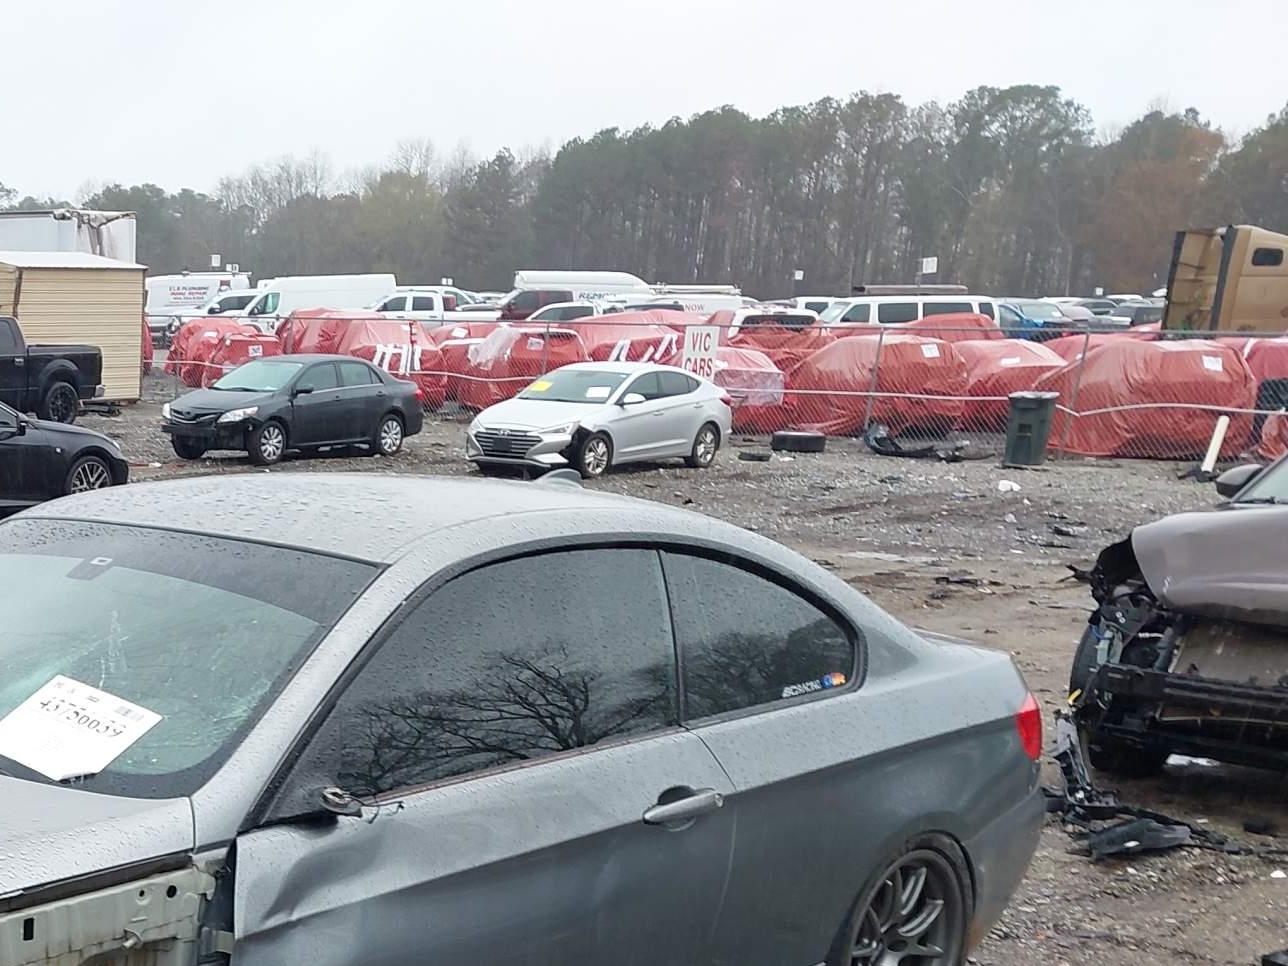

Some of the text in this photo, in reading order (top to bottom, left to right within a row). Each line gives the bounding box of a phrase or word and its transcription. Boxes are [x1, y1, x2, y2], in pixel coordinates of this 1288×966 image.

[684, 304, 705, 312] NOW
[692, 332, 712, 352] VIC
[684, 357, 713, 377] CARS
